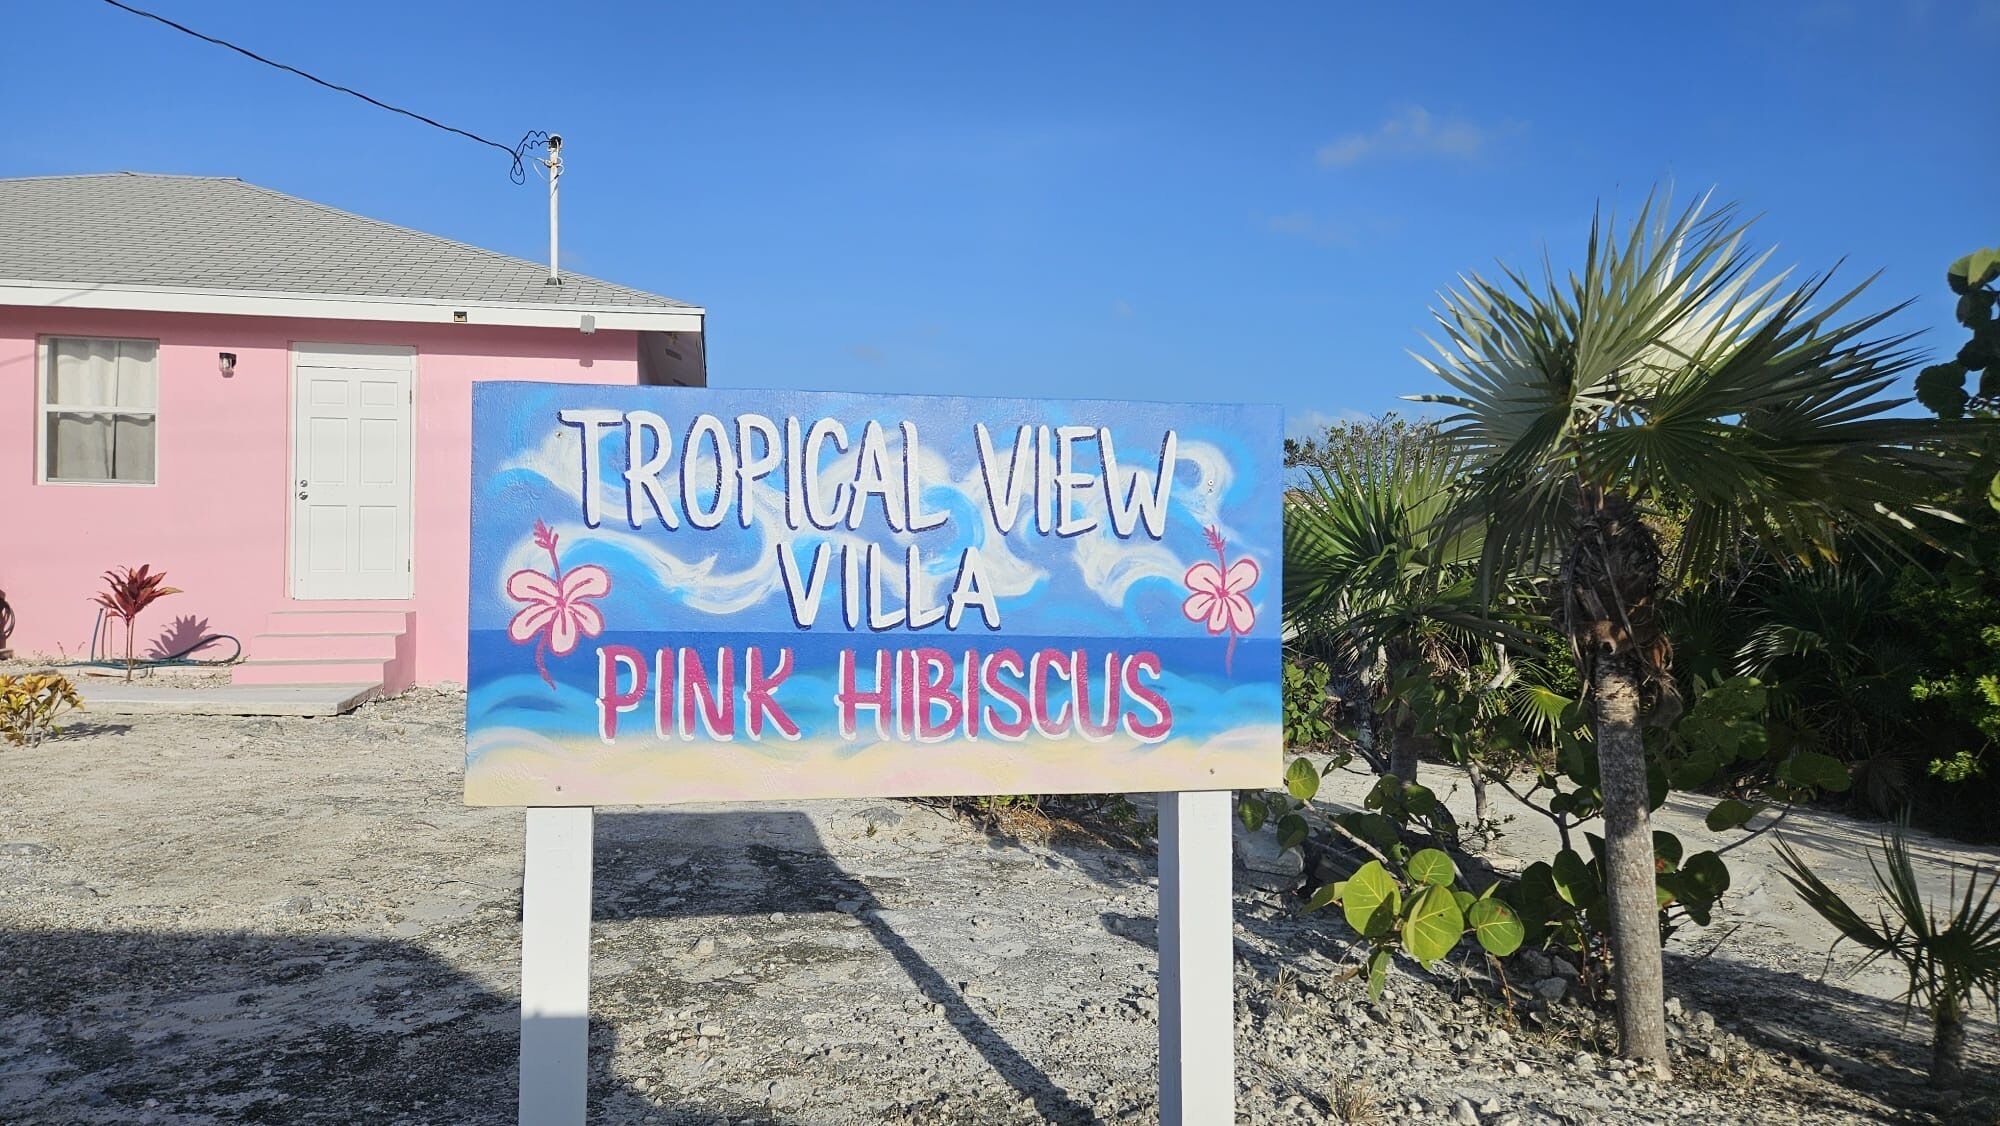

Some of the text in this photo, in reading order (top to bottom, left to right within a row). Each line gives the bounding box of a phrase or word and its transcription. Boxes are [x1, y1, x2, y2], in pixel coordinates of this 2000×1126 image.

[557, 410, 1177, 540] TROPICAL VIEW
[777, 542, 1001, 632] VILLA
[596, 645, 1174, 744] PINK HIBISCUS
